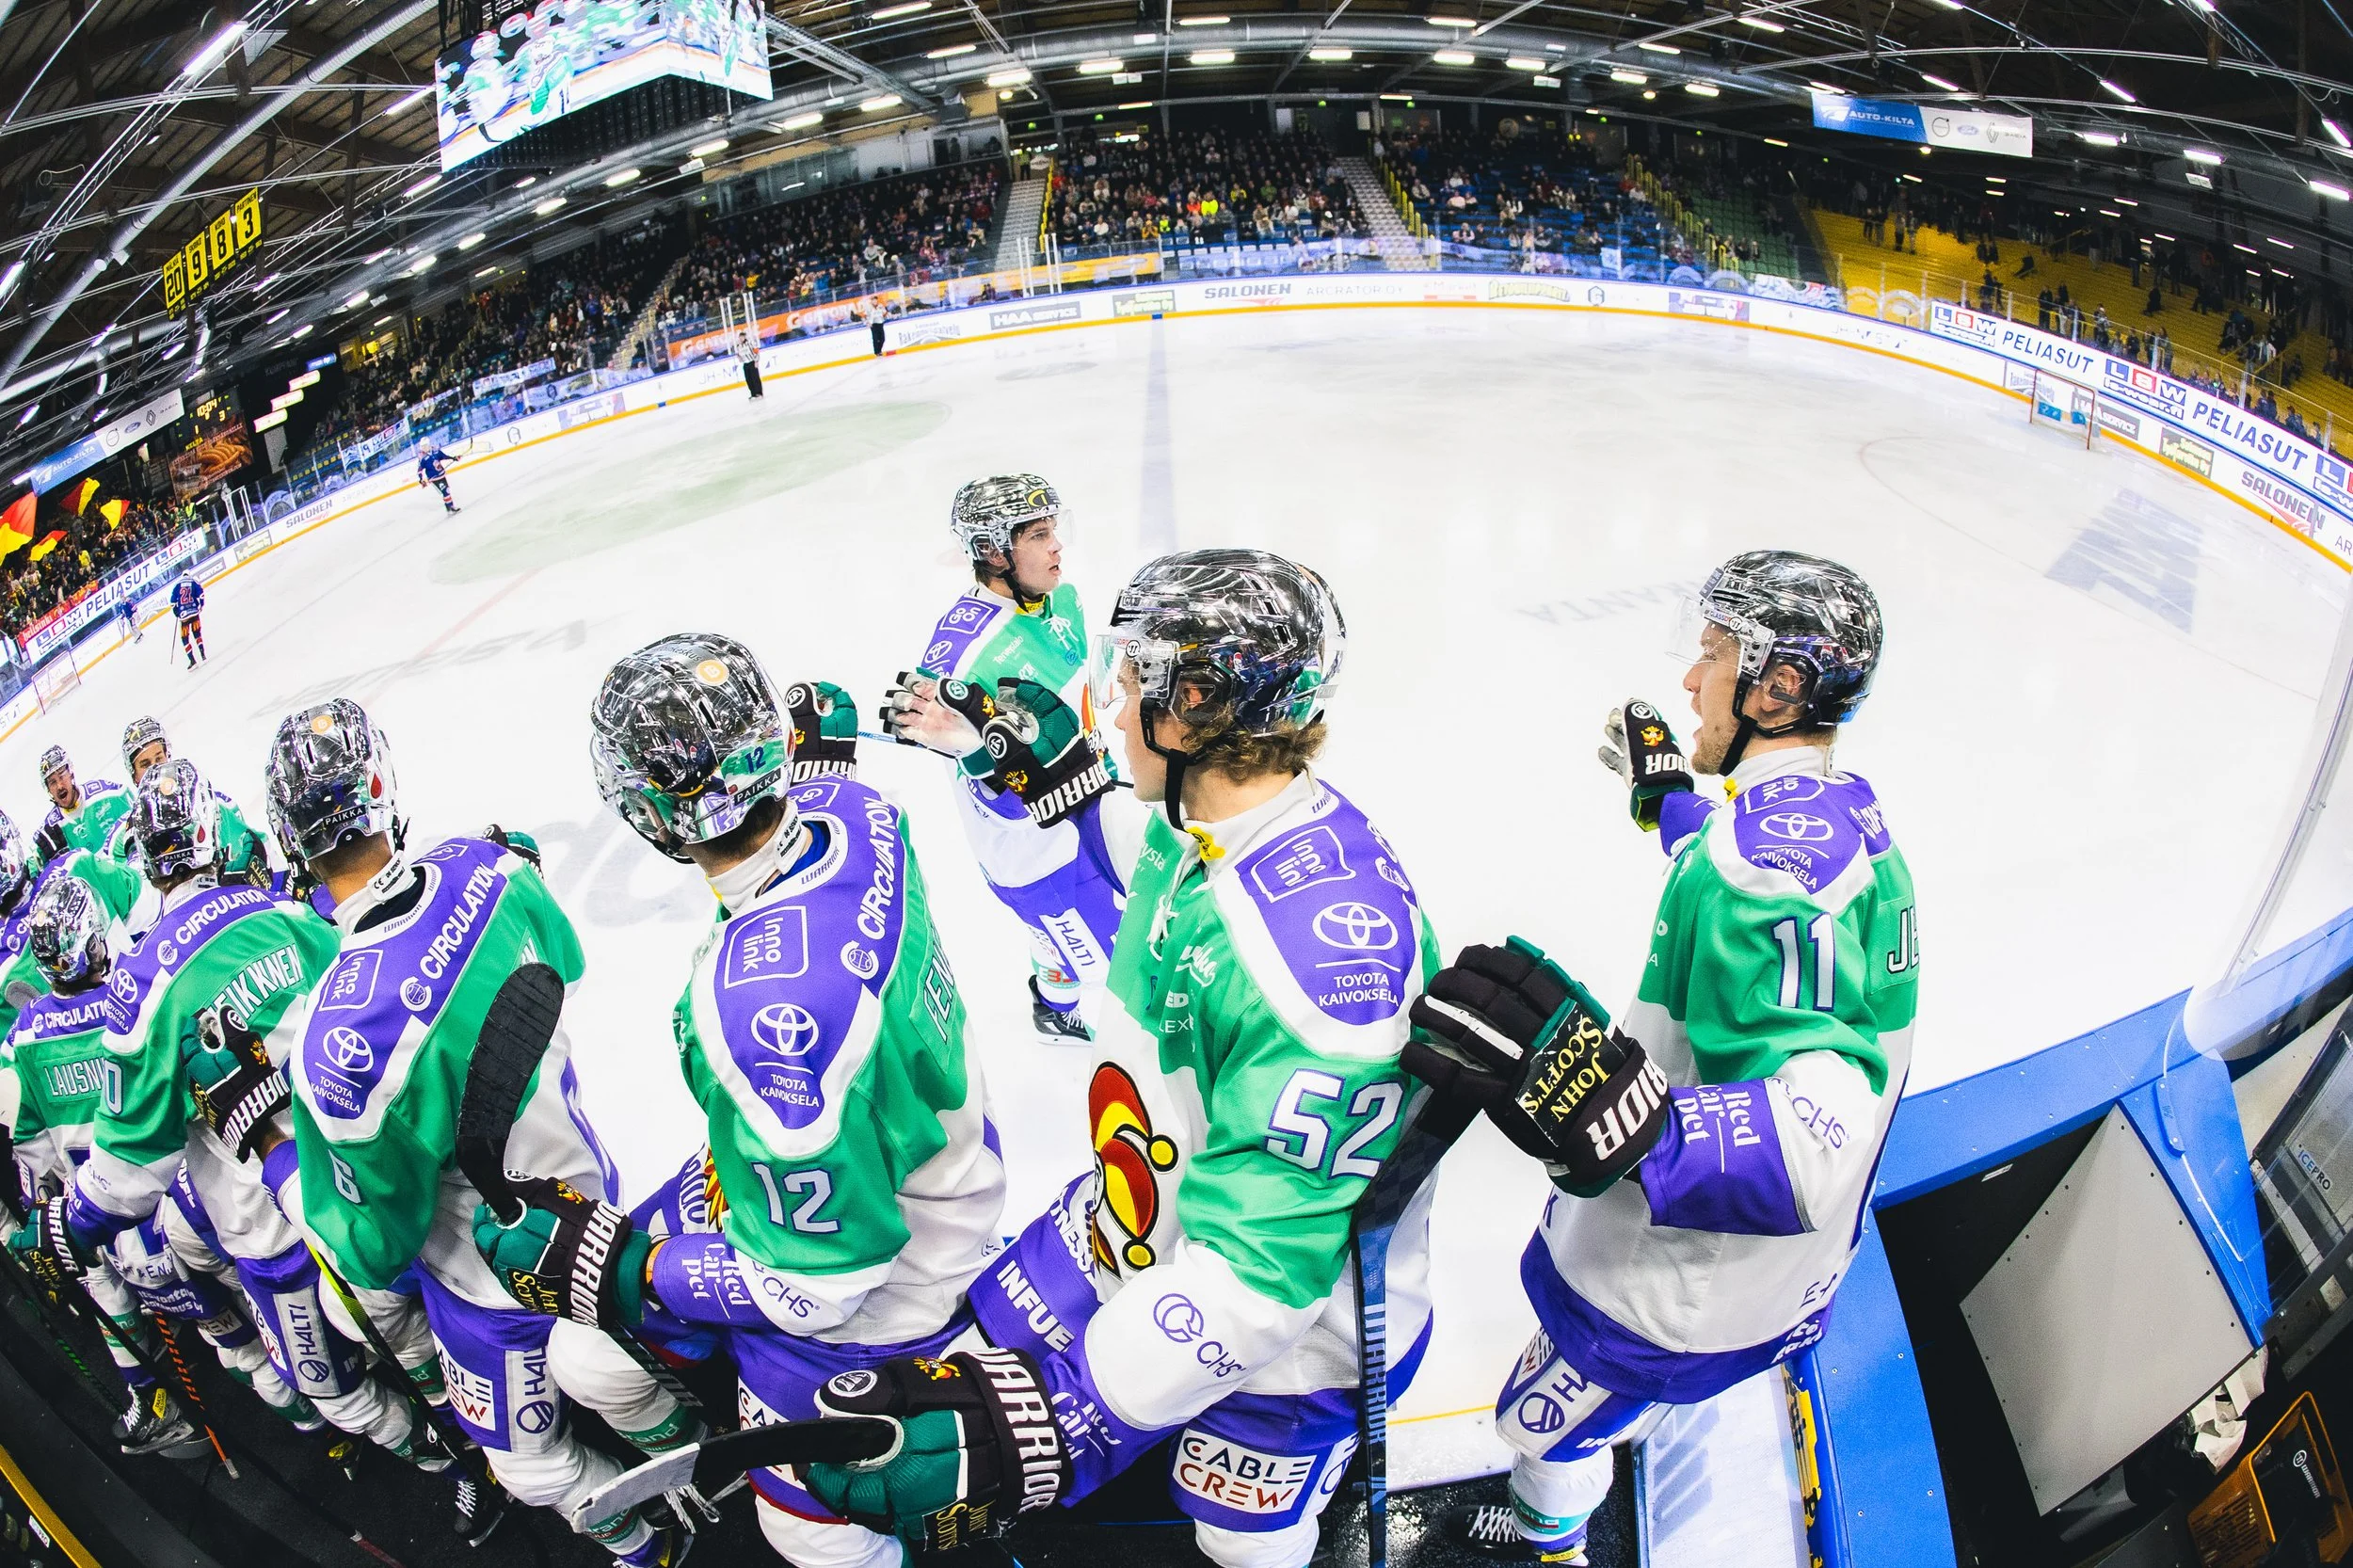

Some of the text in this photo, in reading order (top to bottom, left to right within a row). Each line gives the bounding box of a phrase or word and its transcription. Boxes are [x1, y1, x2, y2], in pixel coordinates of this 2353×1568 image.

[1849, 109, 1915, 127] AUTO-KILTA
[243, 206, 254, 239] 3
[192, 249, 202, 281] 9
[217, 229, 227, 261] 8
[166, 266, 183, 301] 20
[1204, 283, 1292, 299] SALONEN
[1305, 285, 1390, 296] ARCRATOR
[803, 298, 870, 326] GATORAD
[993, 311, 1032, 327] HAA
[2002, 329, 2095, 375] PELIASUT
[197, 398, 218, 418] 10:04
[218, 409, 226, 423] 3
[2192, 400, 2309, 472] PELIASUT
[53, 445, 96, 472] AUTO-KILTA
[285, 499, 333, 529] SALONEN
[2241, 470, 2327, 531] SALONEN
[86, 563, 151, 618] PELIASUT
[744, 746, 766, 774] 12
[736, 771, 781, 803] PAIKKA
[324, 806, 364, 827] PAIKKA
[163, 851, 192, 862] PAIKKA
[174, 888, 275, 944] CIRCULATION
[742, 933, 765, 973] link
[762, 917, 784, 964] Inno
[1055, 920, 1096, 967] HALTI
[346, 955, 366, 995] Inno
[1334, 972, 1390, 989] TOYOTA
[1770, 911, 1835, 1013] 11
[330, 968, 345, 1000] link
[1318, 987, 1400, 1008] KAIVOKSELA
[770, 1073, 808, 1093] TOYOTA
[1523, 1015, 1604, 1116] SCOTT'S
[310, 1080, 361, 1114] KAIVOKSELA
[318, 1075, 354, 1100] TOYOTA
[760, 1086, 820, 1109] KAIVOKSELA
[1550, 1051, 1611, 1123] JOHN
[1262, 1066, 1406, 1181] 52
[1673, 1096, 1711, 1145] pet
[1721, 1089, 1762, 1148] Red
[1791, 1095, 1847, 1149] CHS
[2297, 1149, 2332, 1191] ICEPRO
[752, 1160, 840, 1236] 12
[681, 1257, 711, 1300] pet
[722, 1258, 752, 1306] Red
[762, 1273, 815, 1320] CHS
[288, 1303, 318, 1357] HALTI
[436, 1348, 492, 1404] ABLE
[973, 1347, 1064, 1514] WARRIOR
[1183, 1436, 1317, 1485] CABLE
[1179, 1463, 1296, 1511] CREW
[2300, 1464, 2322, 1498] WARRIOR
